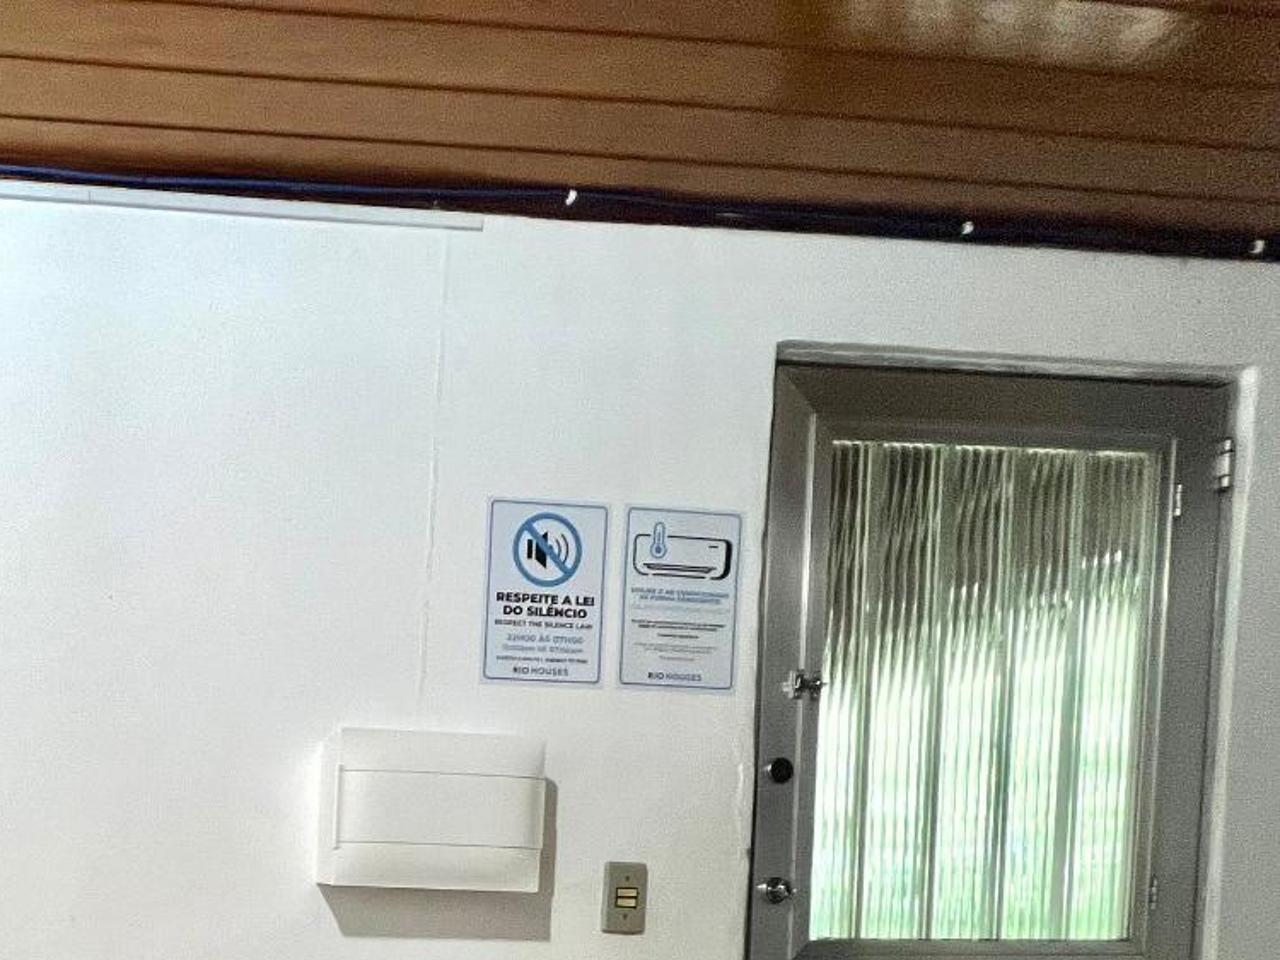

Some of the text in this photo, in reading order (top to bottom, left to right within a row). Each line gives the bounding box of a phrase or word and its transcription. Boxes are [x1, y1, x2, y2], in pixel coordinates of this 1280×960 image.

[496, 591, 595, 607] RESPEITE A LEI
[503, 603, 587, 618] DO SILÊNCIO
